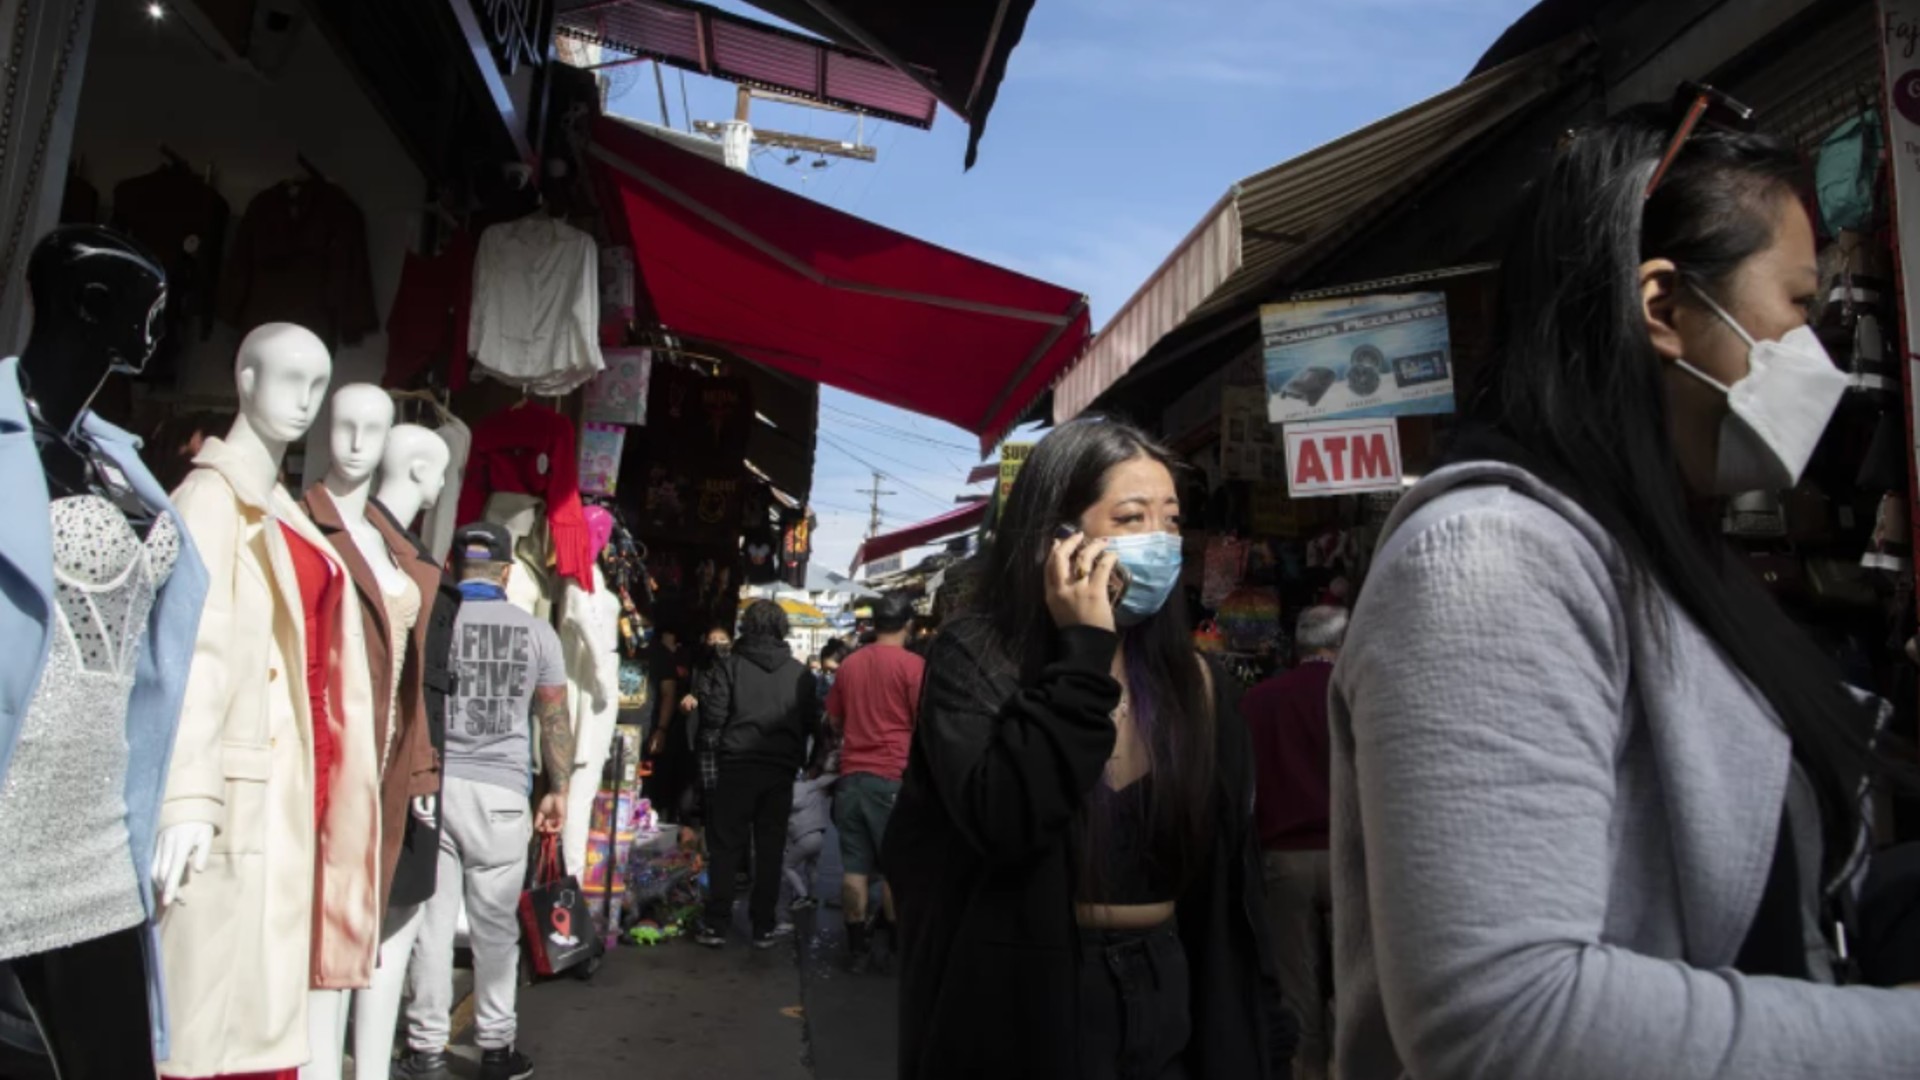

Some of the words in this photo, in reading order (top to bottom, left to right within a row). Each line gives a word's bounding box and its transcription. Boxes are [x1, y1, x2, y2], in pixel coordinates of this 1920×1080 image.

[1294, 433, 1393, 484] ATM
[462, 623, 529, 662] FIVE
[459, 661, 528, 697] FIVE
